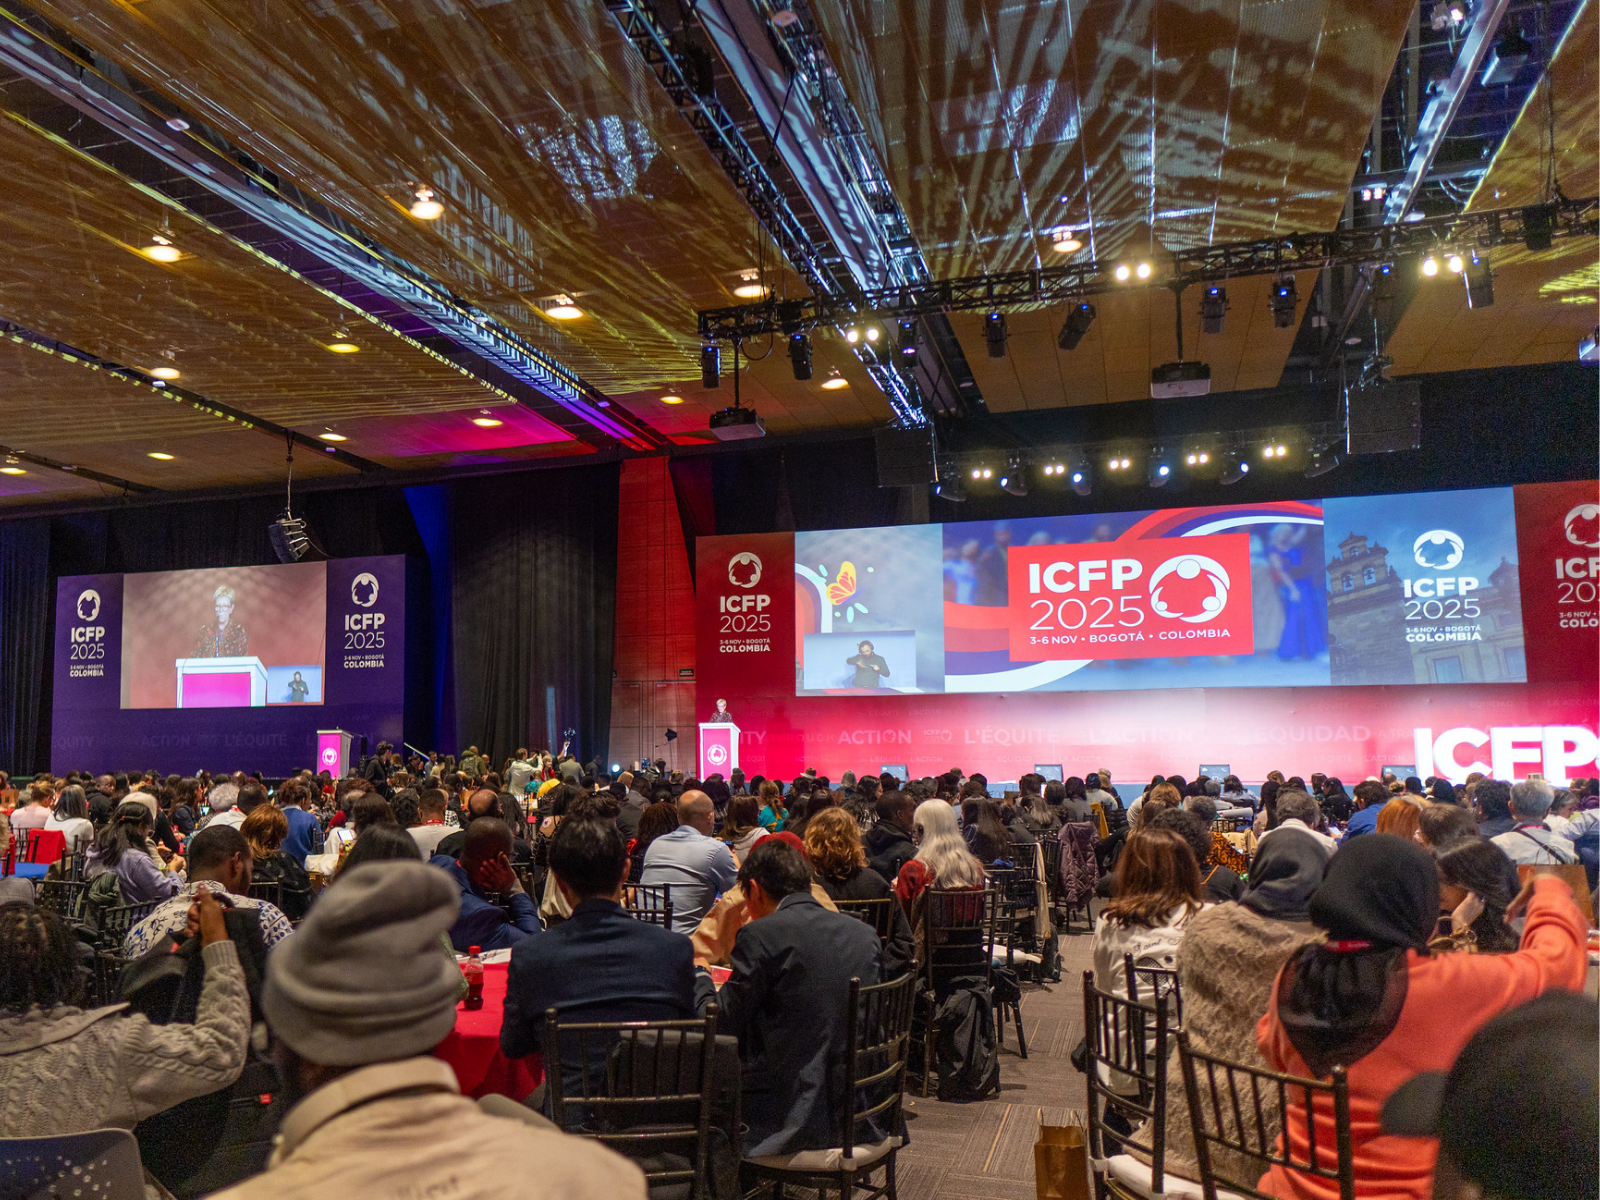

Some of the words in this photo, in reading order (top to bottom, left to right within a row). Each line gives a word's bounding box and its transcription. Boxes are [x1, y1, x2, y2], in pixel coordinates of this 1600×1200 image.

[1029, 558, 1143, 594] ICFP
[1555, 557, 1599, 579] ICF
[1403, 576, 1479, 598] ICFP
[1557, 581, 1599, 603] 20
[720, 594, 771, 613] ICFP
[1030, 595, 1145, 630] 2025
[1404, 598, 1481, 620] 2025
[344, 613, 386, 631] ICFP
[719, 614, 771, 633] 2025
[1445, 624, 1482, 632] BOGOTÁ
[1559, 618, 1599, 628] COLO
[71, 626, 105, 643] ICFP
[344, 631, 385, 650] 2025
[1030, 636, 1049, 645] 3-6
[1051, 635, 1078, 644] NOV
[1089, 631, 1145, 643] BOGOTÁ
[1159, 629, 1231, 641] COLOMBIA
[1405, 632, 1482, 643] COLOMBIA
[70, 643, 105, 660] 2025
[719, 644, 771, 653] COLOMBIA
[69, 669, 104, 678] COLOMBIA
[344, 660, 385, 669] COLOMBIA
[740, 731, 767, 745] ITY
[837, 729, 912, 745] ACTION
[964, 725, 1060, 746] L'ÉQUITÉ
[1413, 726, 1598, 787] ICFP
